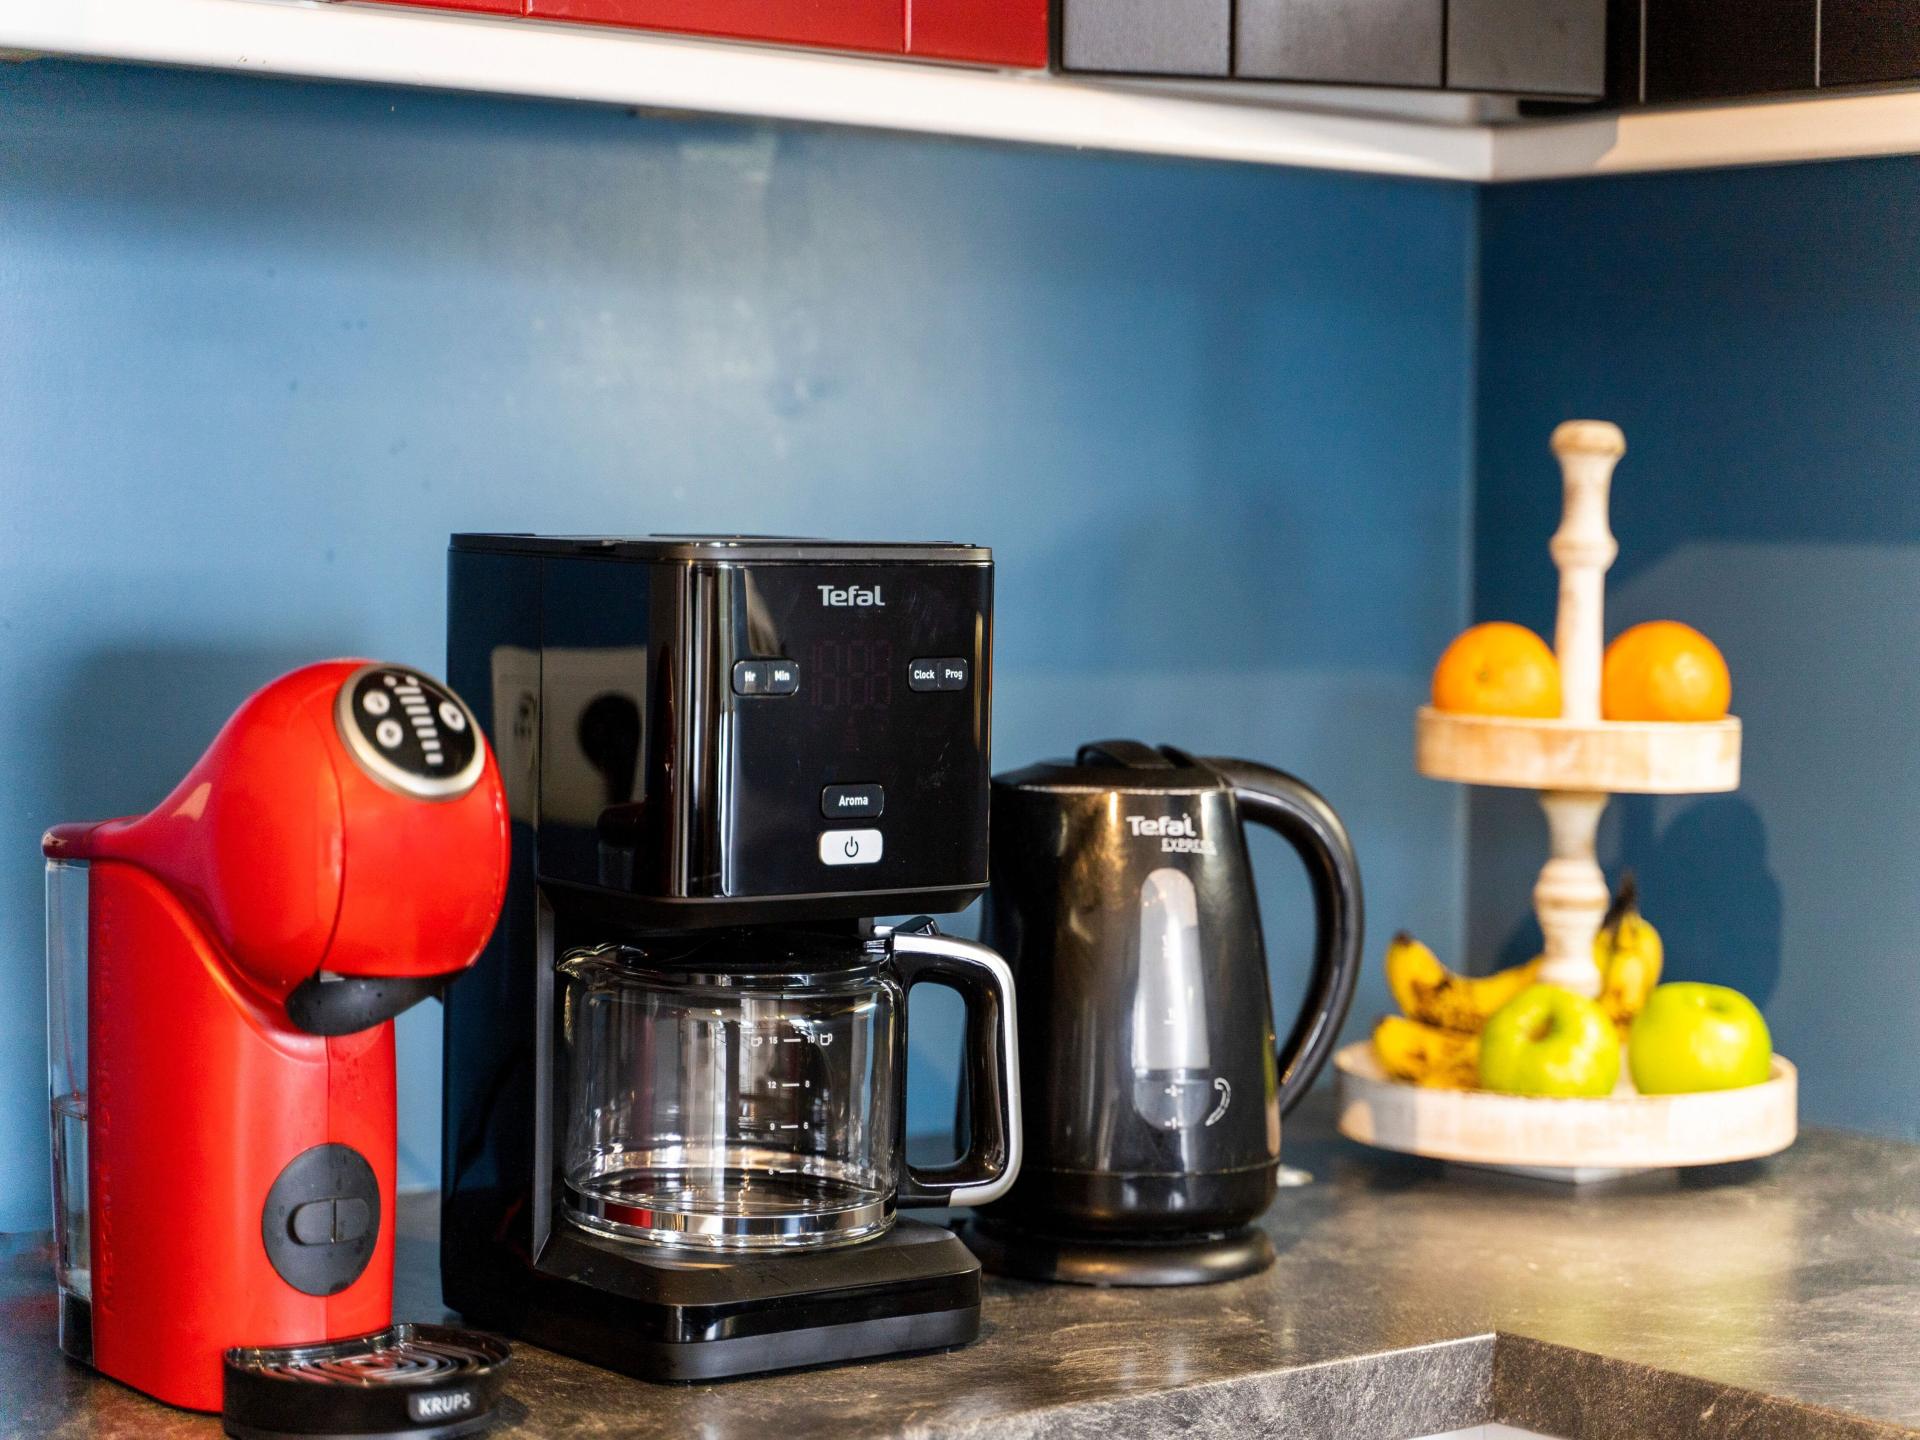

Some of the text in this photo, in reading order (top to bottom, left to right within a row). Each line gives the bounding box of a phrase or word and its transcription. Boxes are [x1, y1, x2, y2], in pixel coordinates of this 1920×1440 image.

[817, 585, 886, 607] Tefal
[744, 671, 756, 683] Hr
[774, 670, 790, 682] Min
[914, 669, 935, 680] Clock
[945, 669, 963, 680] Prog
[838, 795, 869, 807] Aroma
[1125, 813, 1197, 837] Tefal
[768, 1036, 778, 1044] 15
[767, 1081, 777, 1089] 12
[769, 1123, 775, 1131] 9
[418, 1392, 471, 1417] KRUPS
